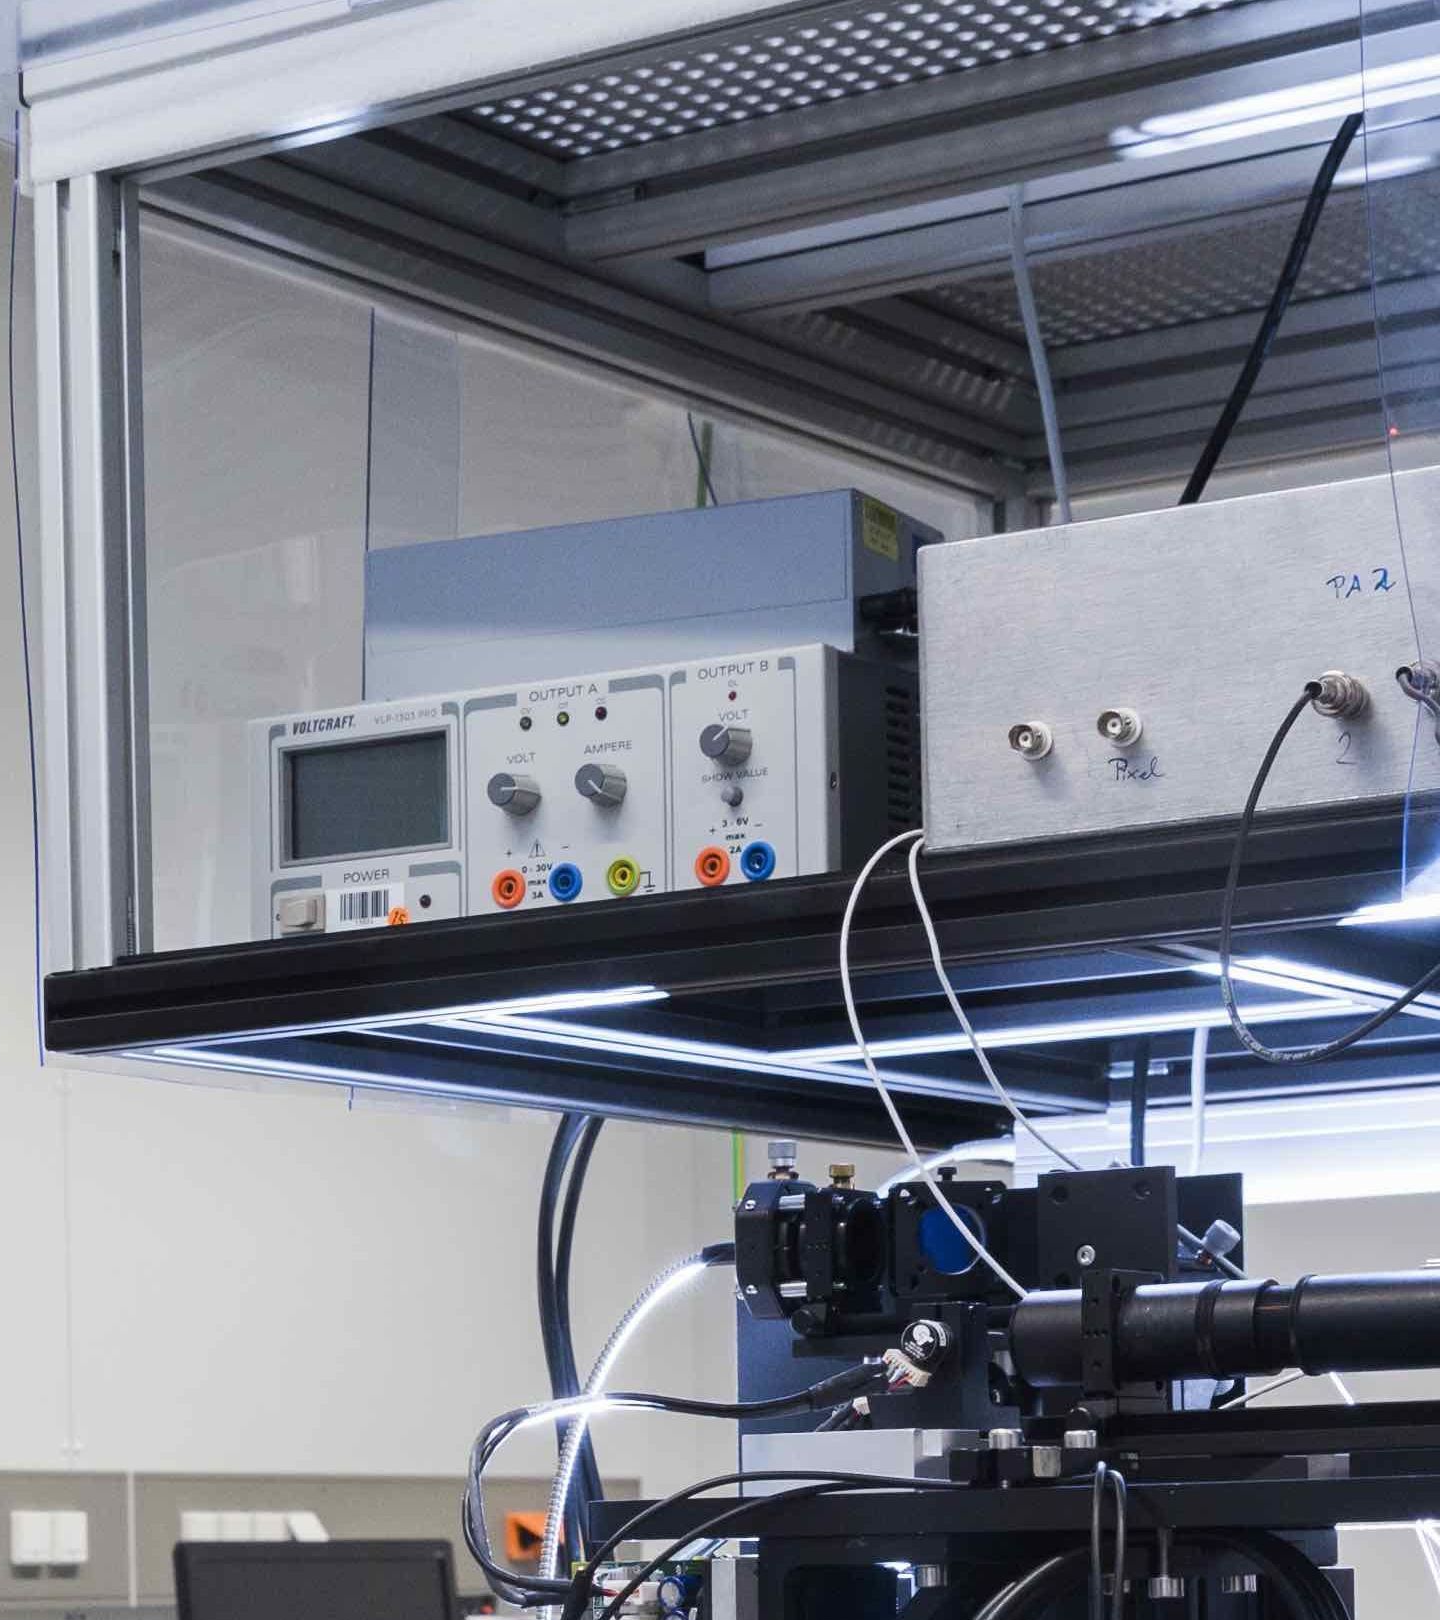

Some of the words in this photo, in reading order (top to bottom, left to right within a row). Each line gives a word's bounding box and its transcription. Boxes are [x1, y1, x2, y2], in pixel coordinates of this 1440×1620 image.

[698, 662, 754, 680] OUTPUT
[760, 660, 769, 672] B
[529, 685, 584, 702] OUTPUT
[588, 684, 598, 694] A
[719, 709, 749, 722] VOLT
[584, 740, 633, 755] AMPERE
[1336, 733, 1356, 765] 2
[506, 752, 536, 765] VOLT
[701, 769, 733, 783] SHOW
[736, 767, 769, 780] VALUE
[1107, 756, 1165, 783] Pixel
[725, 832, 745, 841] max
[729, 845, 742, 854] 2A
[344, 869, 390, 883] POWER
